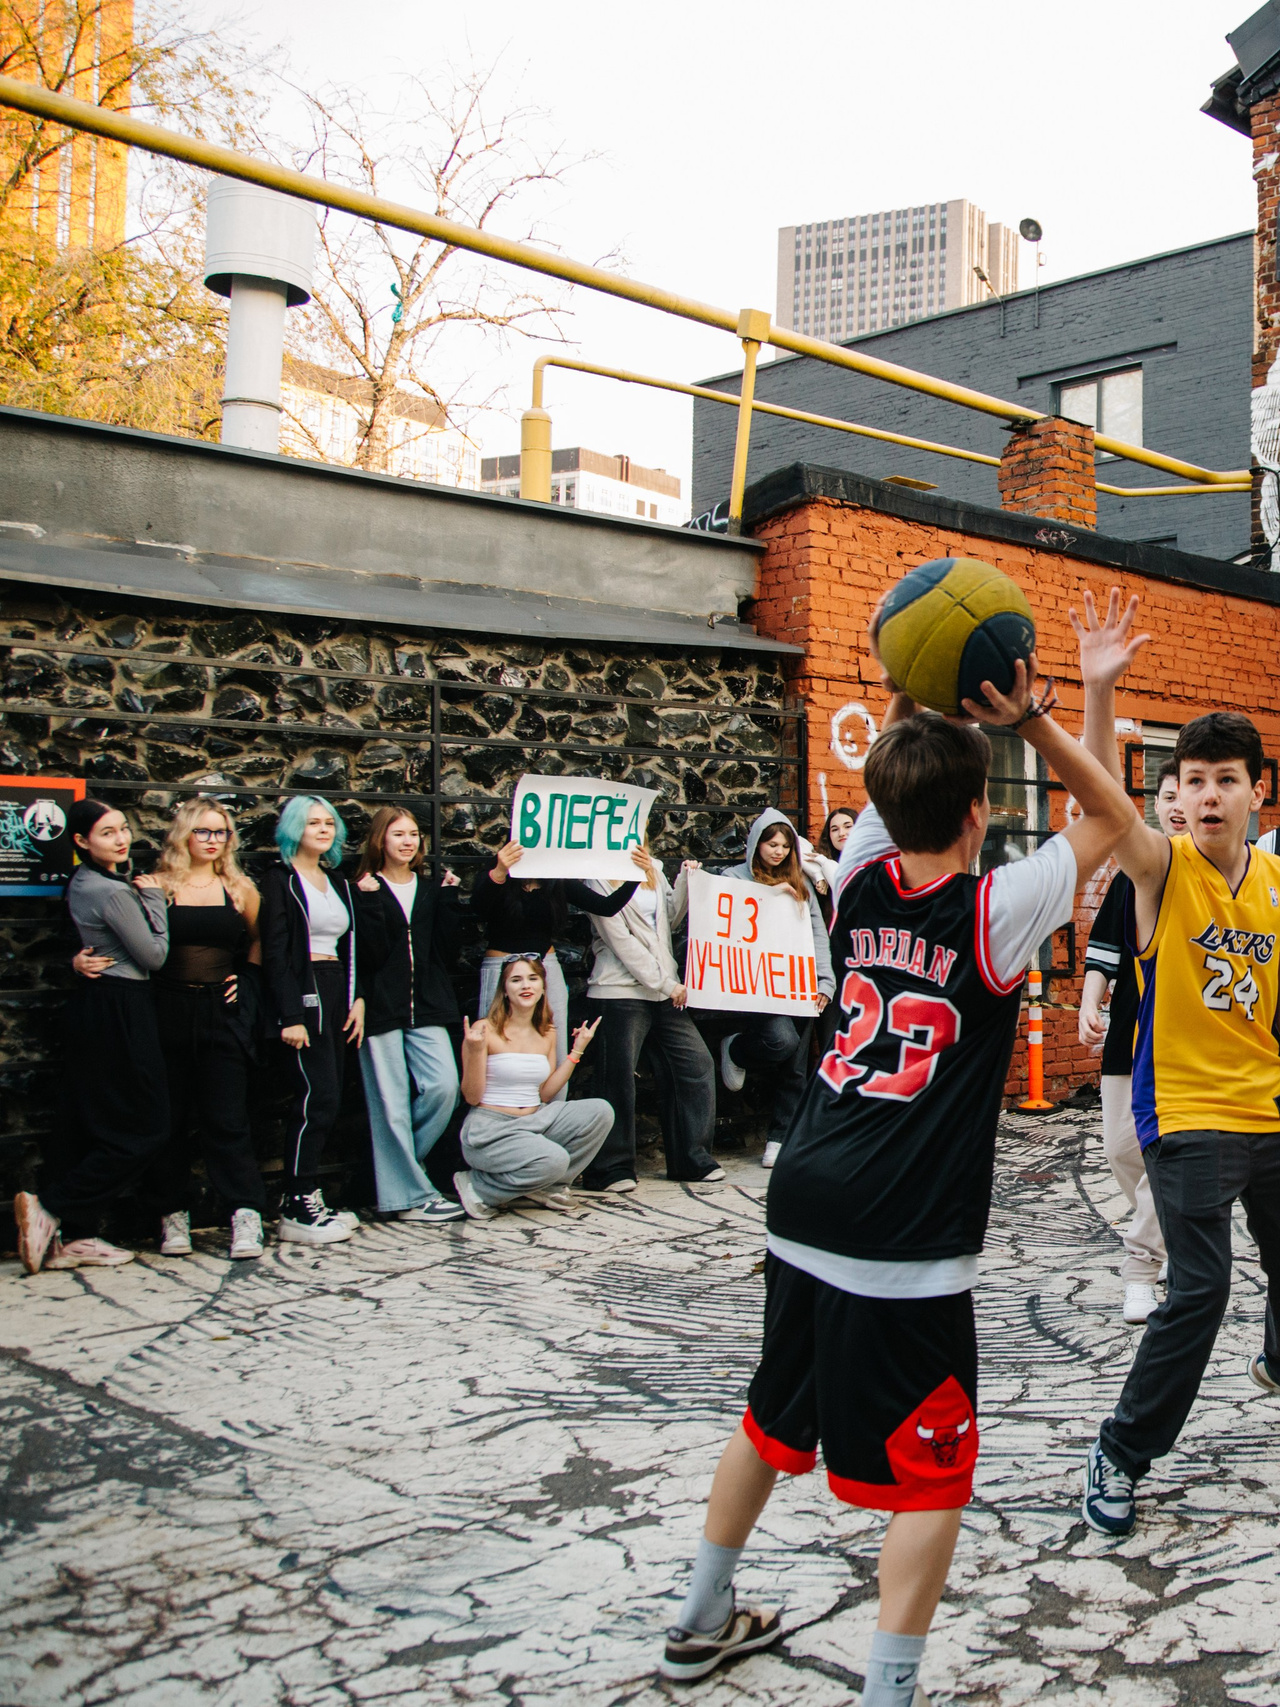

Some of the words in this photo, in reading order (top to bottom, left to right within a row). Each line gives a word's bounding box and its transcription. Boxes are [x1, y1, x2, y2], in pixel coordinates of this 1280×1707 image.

[686, 938, 819, 1001] ЛУЧШИЕ!!!
[845, 927, 958, 988] JORDAN
[1201, 954, 1260, 1021] 24
[817, 970, 961, 1103] 23
